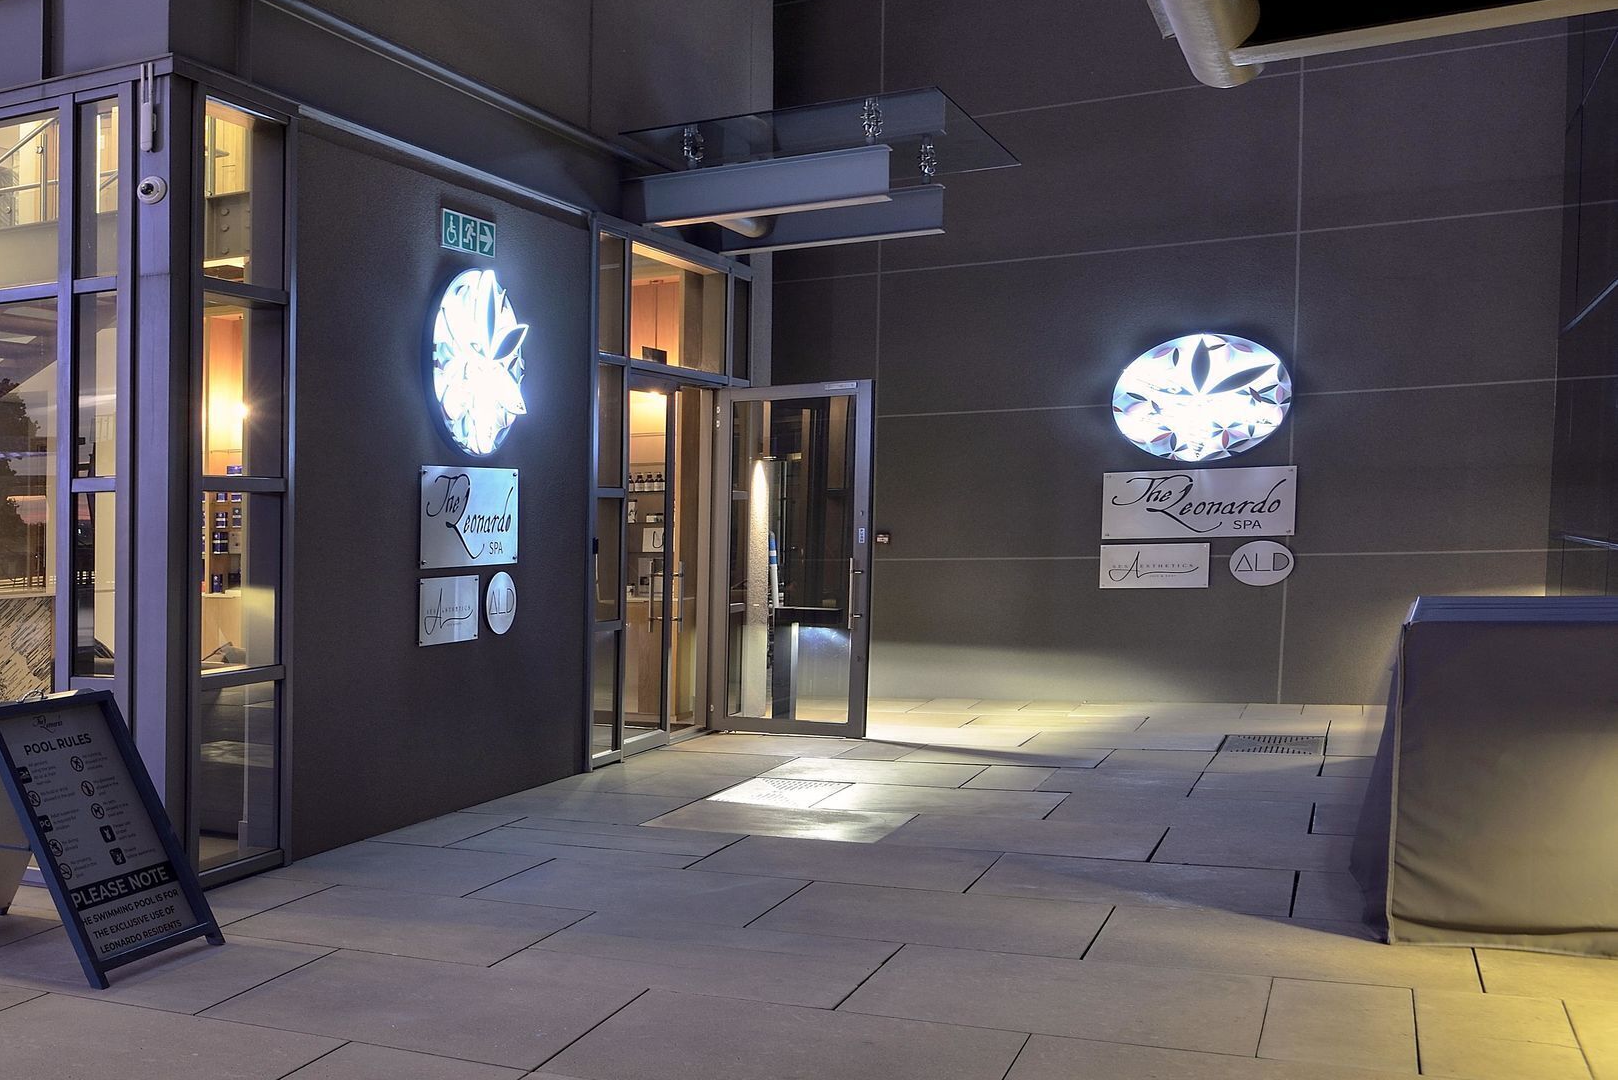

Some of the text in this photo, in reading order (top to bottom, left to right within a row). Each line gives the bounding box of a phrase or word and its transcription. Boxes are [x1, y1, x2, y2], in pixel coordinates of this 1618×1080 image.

[426, 474, 514, 559] The Leonardo
[1146, 475, 1287, 533] Leonardo
[1233, 519, 1262, 530] SPA
[489, 541, 504, 555] SPA
[23, 733, 92, 756] POOL RULES
[70, 880, 129, 909] PLEASE
[128, 866, 170, 891] NOTE
[92, 903, 135, 924] SWIMMING
[134, 896, 157, 910] POOL
[164, 888, 180, 901] FOR
[92, 905, 176, 940] THE EXCLUSIVE USE OF
[99, 919, 183, 954] LEONARDO RESIDENTS
